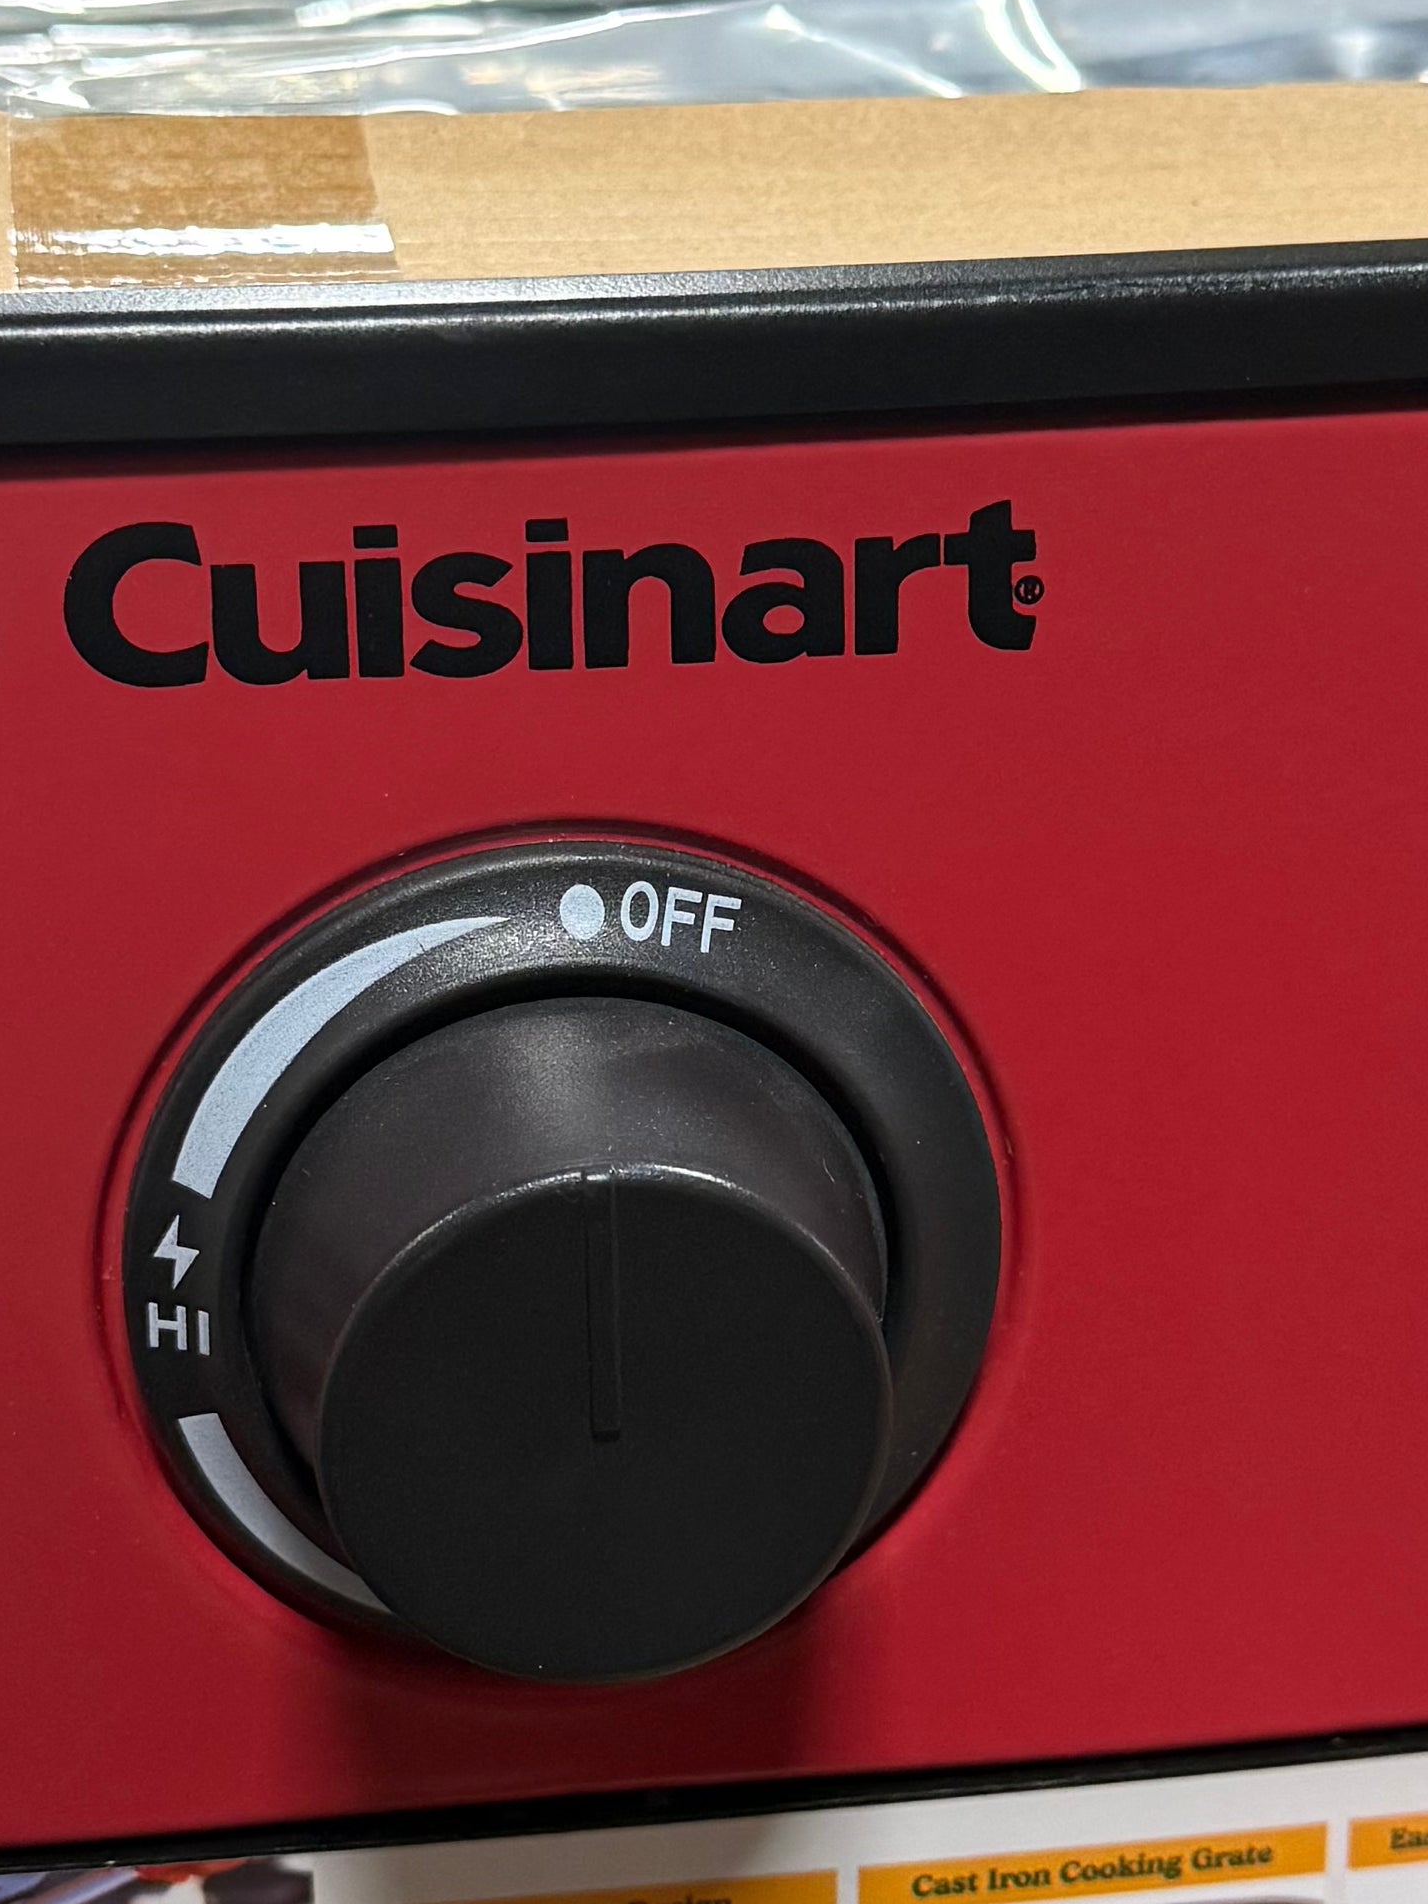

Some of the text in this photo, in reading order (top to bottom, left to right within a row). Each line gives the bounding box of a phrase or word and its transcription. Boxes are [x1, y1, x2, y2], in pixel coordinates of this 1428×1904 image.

[620, 880, 744, 954] OFF
[145, 1301, 212, 1357] HI
[911, 1844, 1274, 1898] Cast Iron Cooking Grate
